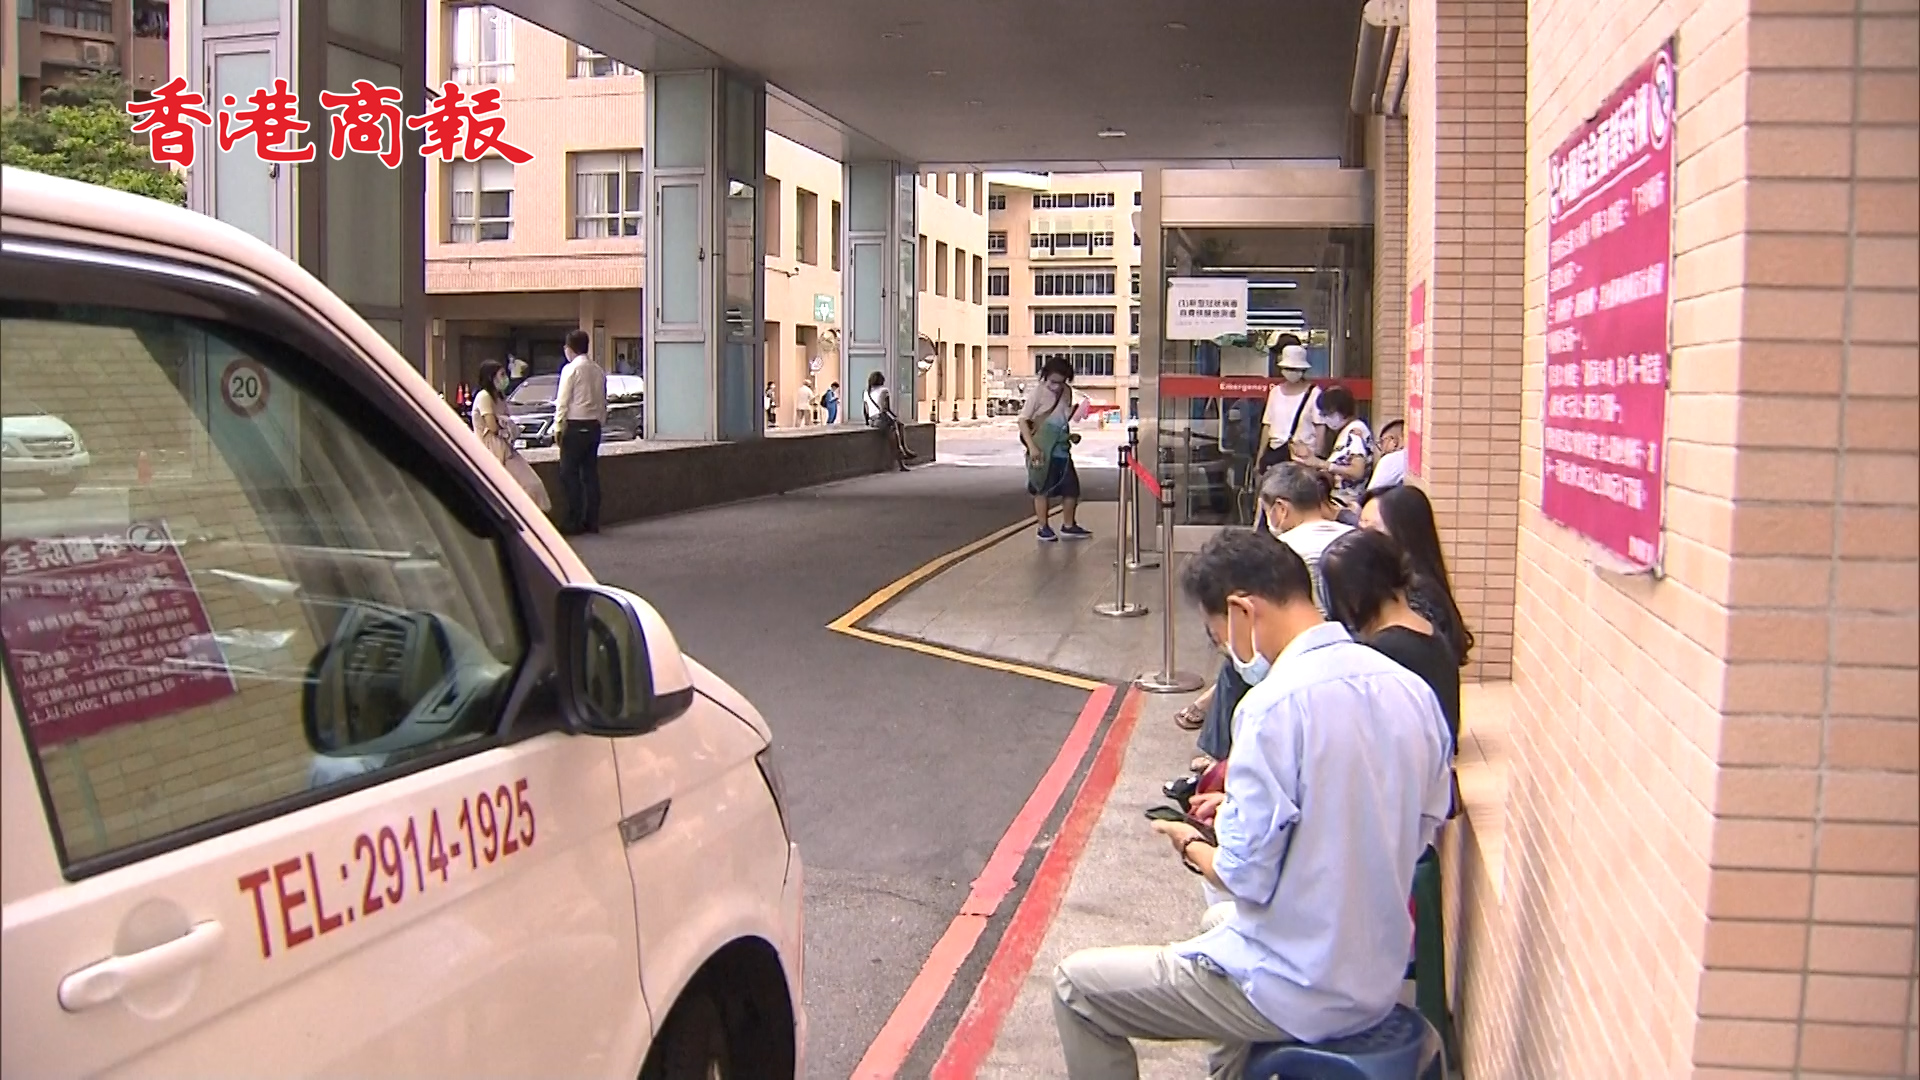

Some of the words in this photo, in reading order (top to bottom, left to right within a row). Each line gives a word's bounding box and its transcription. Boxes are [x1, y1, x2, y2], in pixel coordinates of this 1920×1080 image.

[232, 374, 259, 399] 20
[1219, 383, 1268, 392] Emergency
[237, 777, 536, 959] TEL:2914-1925
